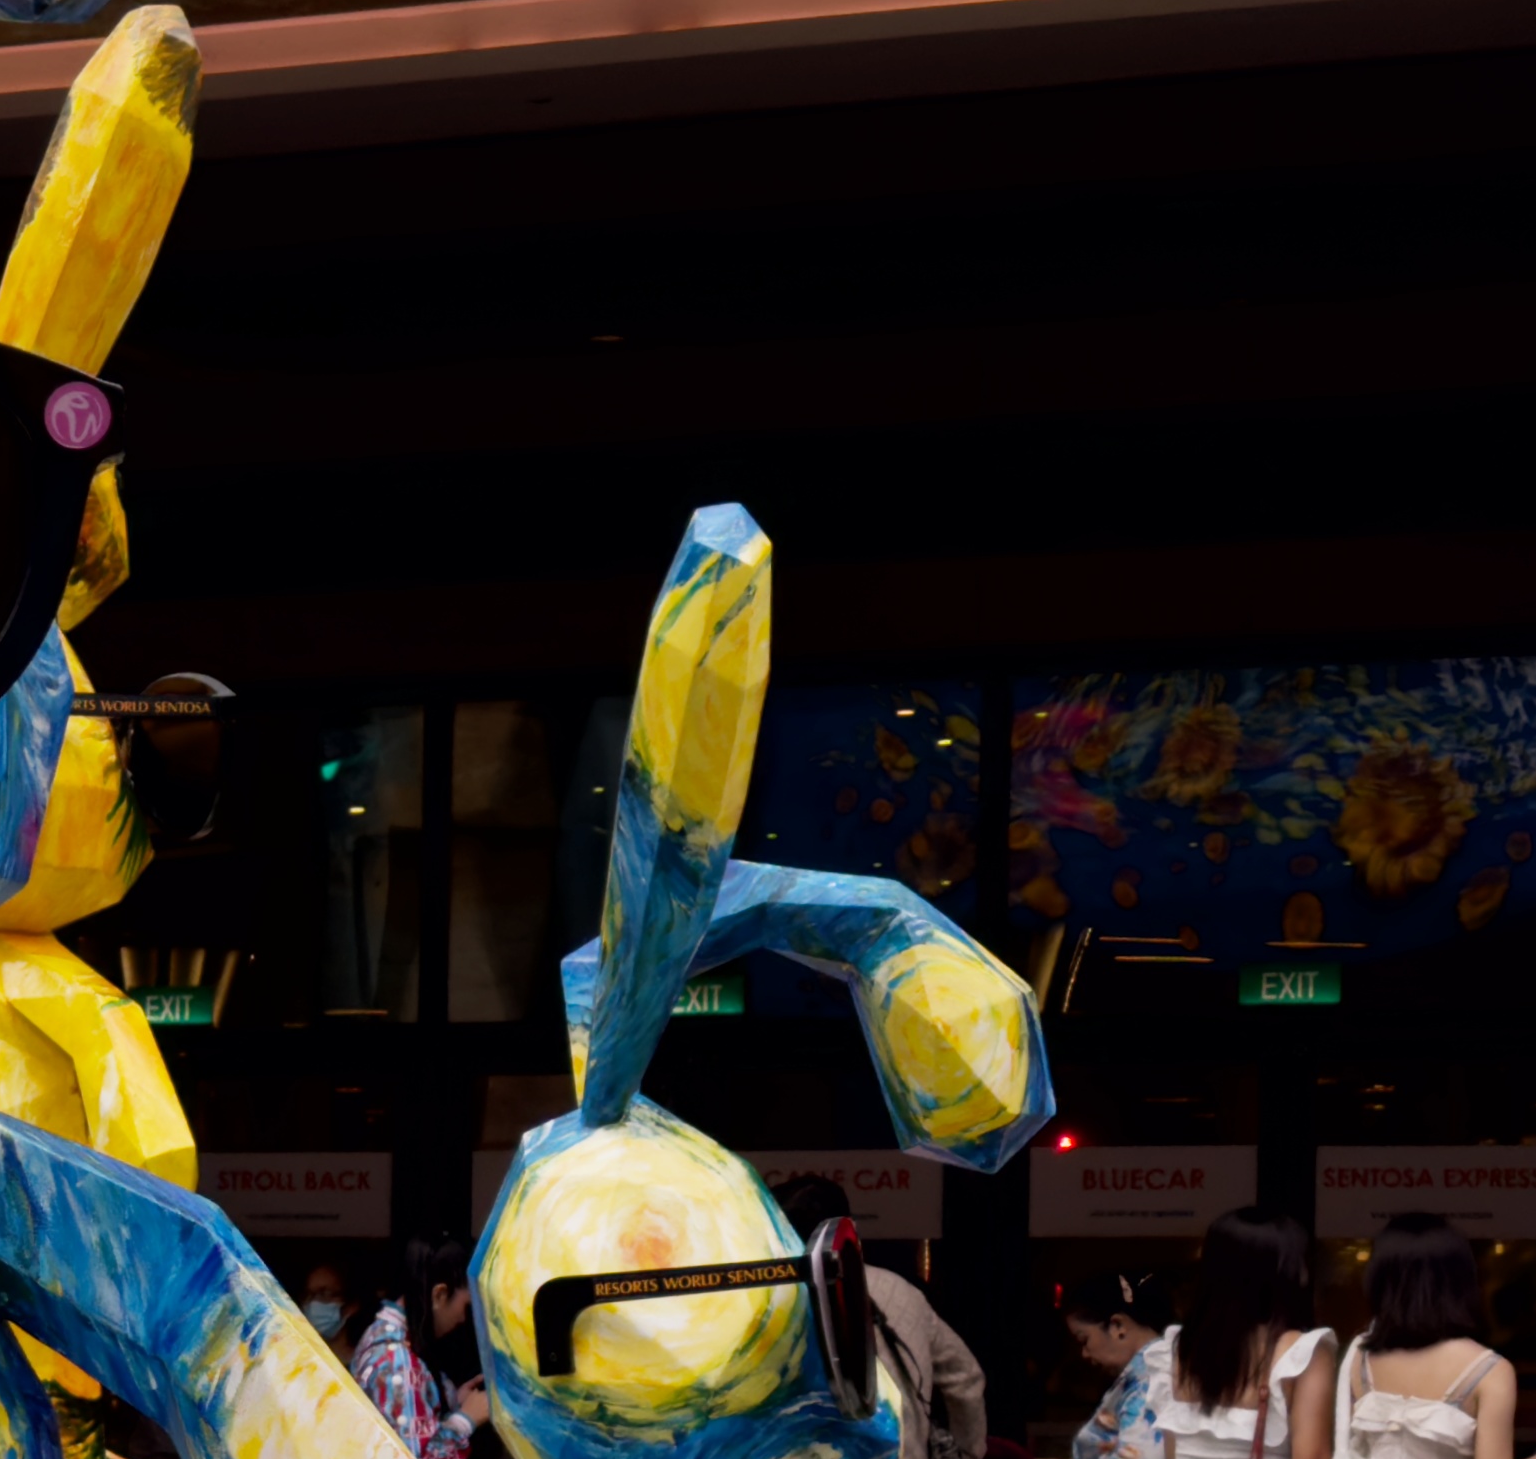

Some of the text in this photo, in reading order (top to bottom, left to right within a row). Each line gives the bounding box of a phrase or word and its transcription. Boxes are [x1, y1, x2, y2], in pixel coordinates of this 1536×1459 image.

[100, 700, 150, 713] WORLD
[154, 700, 211, 714] SENTOSA
[1261, 971, 1320, 1001] EXIT
[145, 994, 194, 1024] EXIT
[217, 1170, 371, 1191] STROLL BACK
[853, 1169, 911, 1191] CAR
[1323, 1167, 1434, 1188] SENTOSA
[594, 1277, 659, 1297] RESORTS
[727, 1264, 797, 1284] SENTOSA
